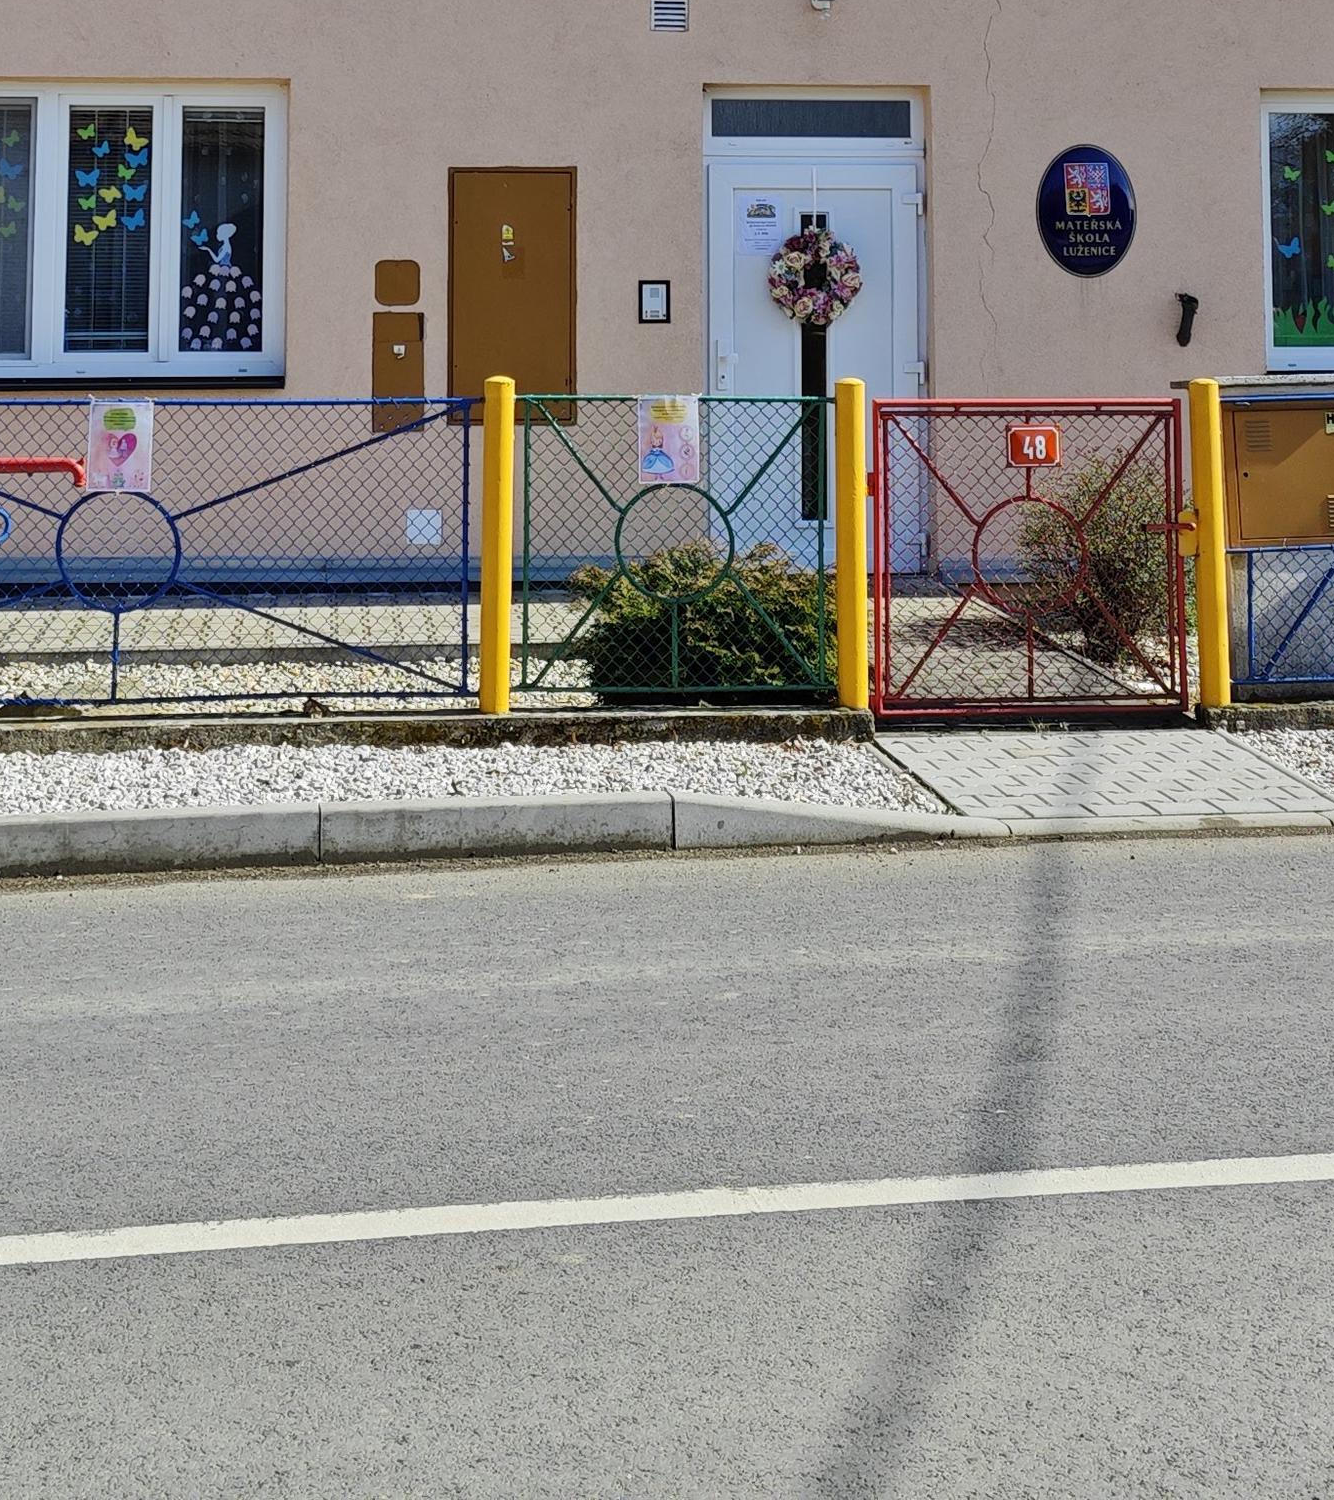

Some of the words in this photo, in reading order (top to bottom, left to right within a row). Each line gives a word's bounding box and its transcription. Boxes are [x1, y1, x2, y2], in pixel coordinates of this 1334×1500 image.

[1055, 218, 1122, 230] MATEŘSKÁ
[1069, 232, 1110, 243] ŠKOLA
[1063, 244, 1116, 256] LUŽENICE
[1023, 435, 1046, 460] 48
